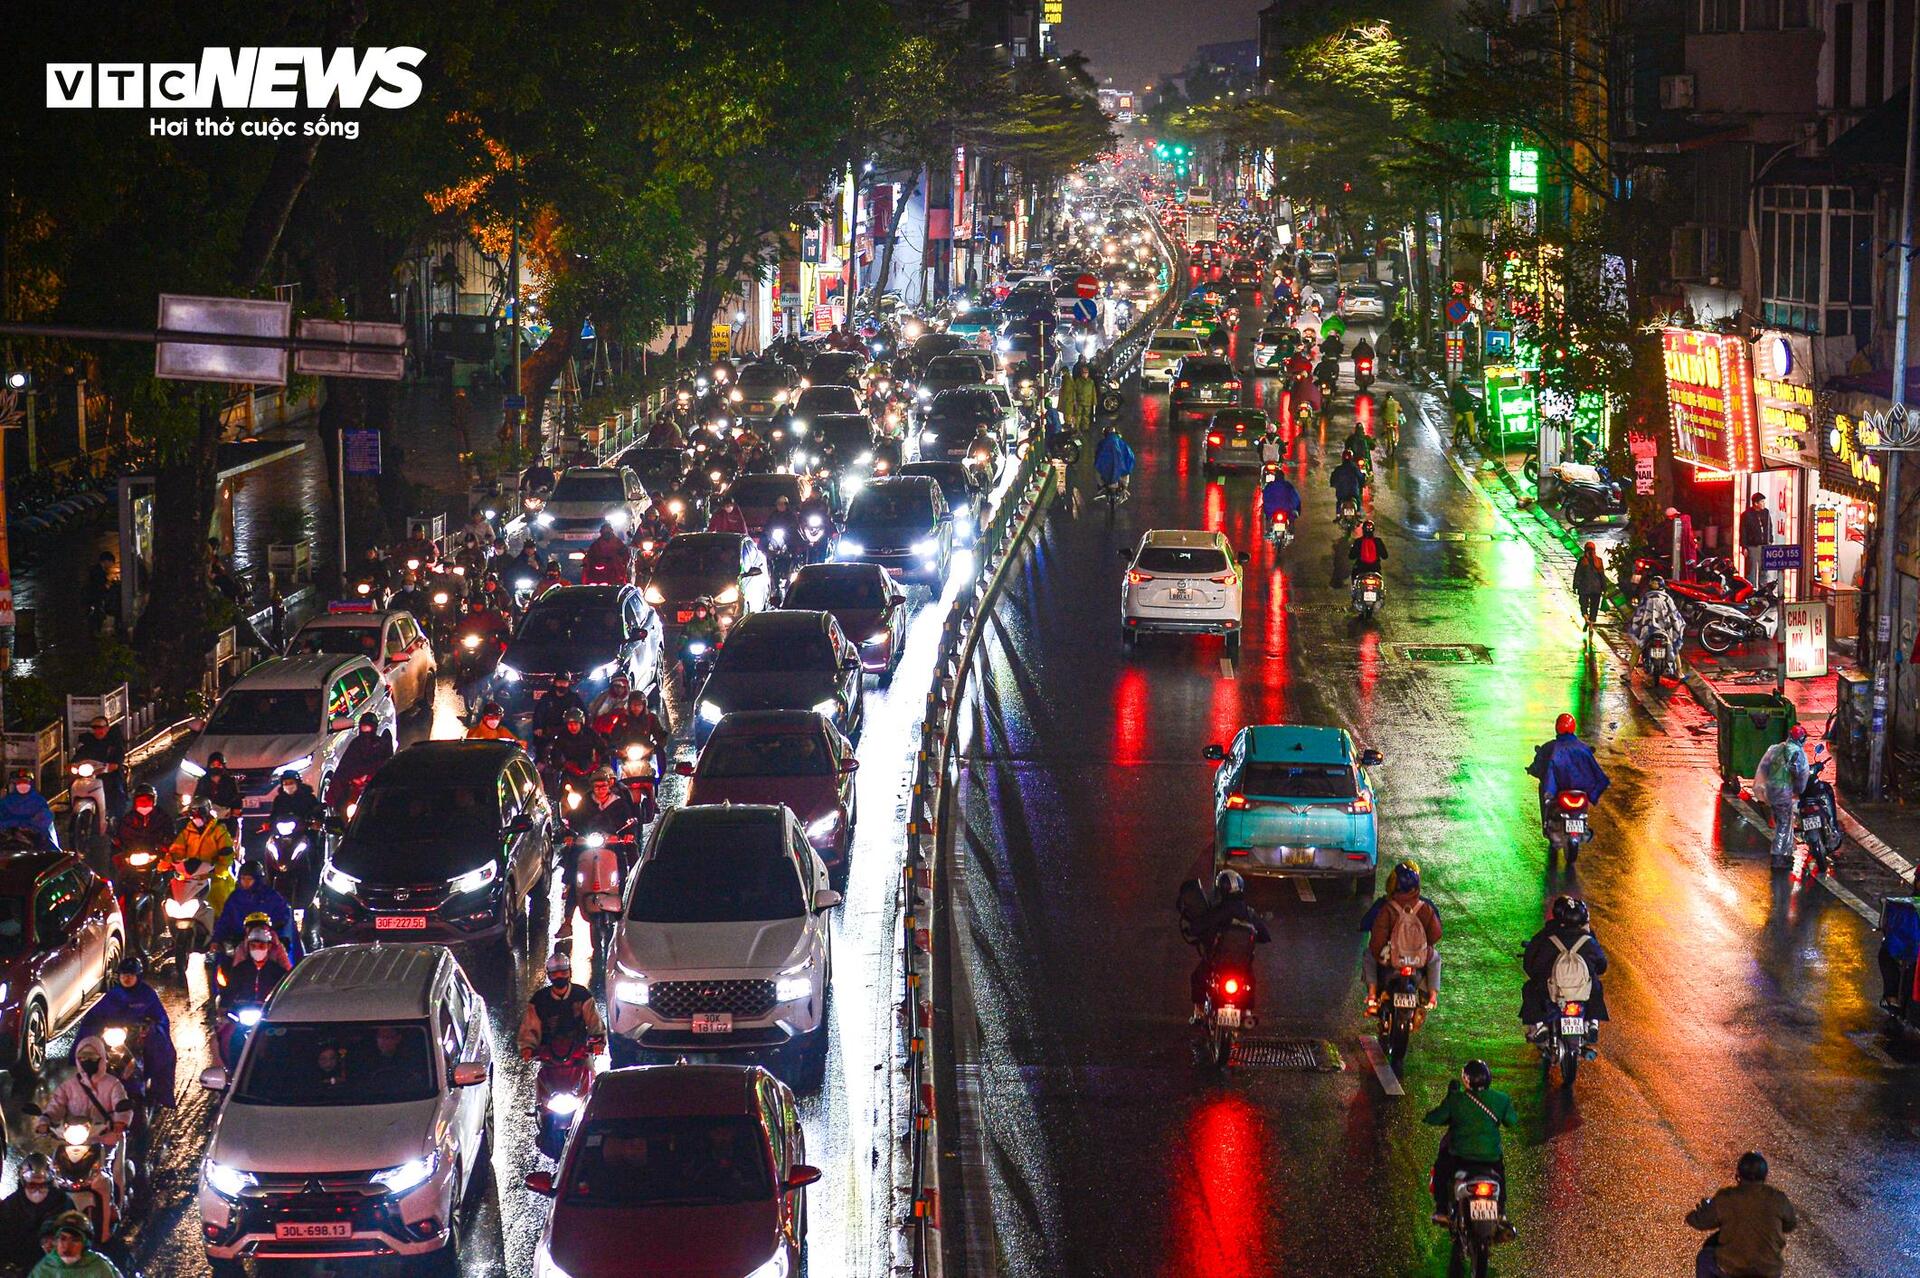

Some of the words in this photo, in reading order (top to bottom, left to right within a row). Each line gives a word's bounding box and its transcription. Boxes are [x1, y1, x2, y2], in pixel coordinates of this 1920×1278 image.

[1786, 550, 1799, 558] 155
[1787, 607, 1807, 627] CHÁO
[703, 1014, 721, 1023] 30K
[283, 1226, 345, 1237] 30L-698.13
